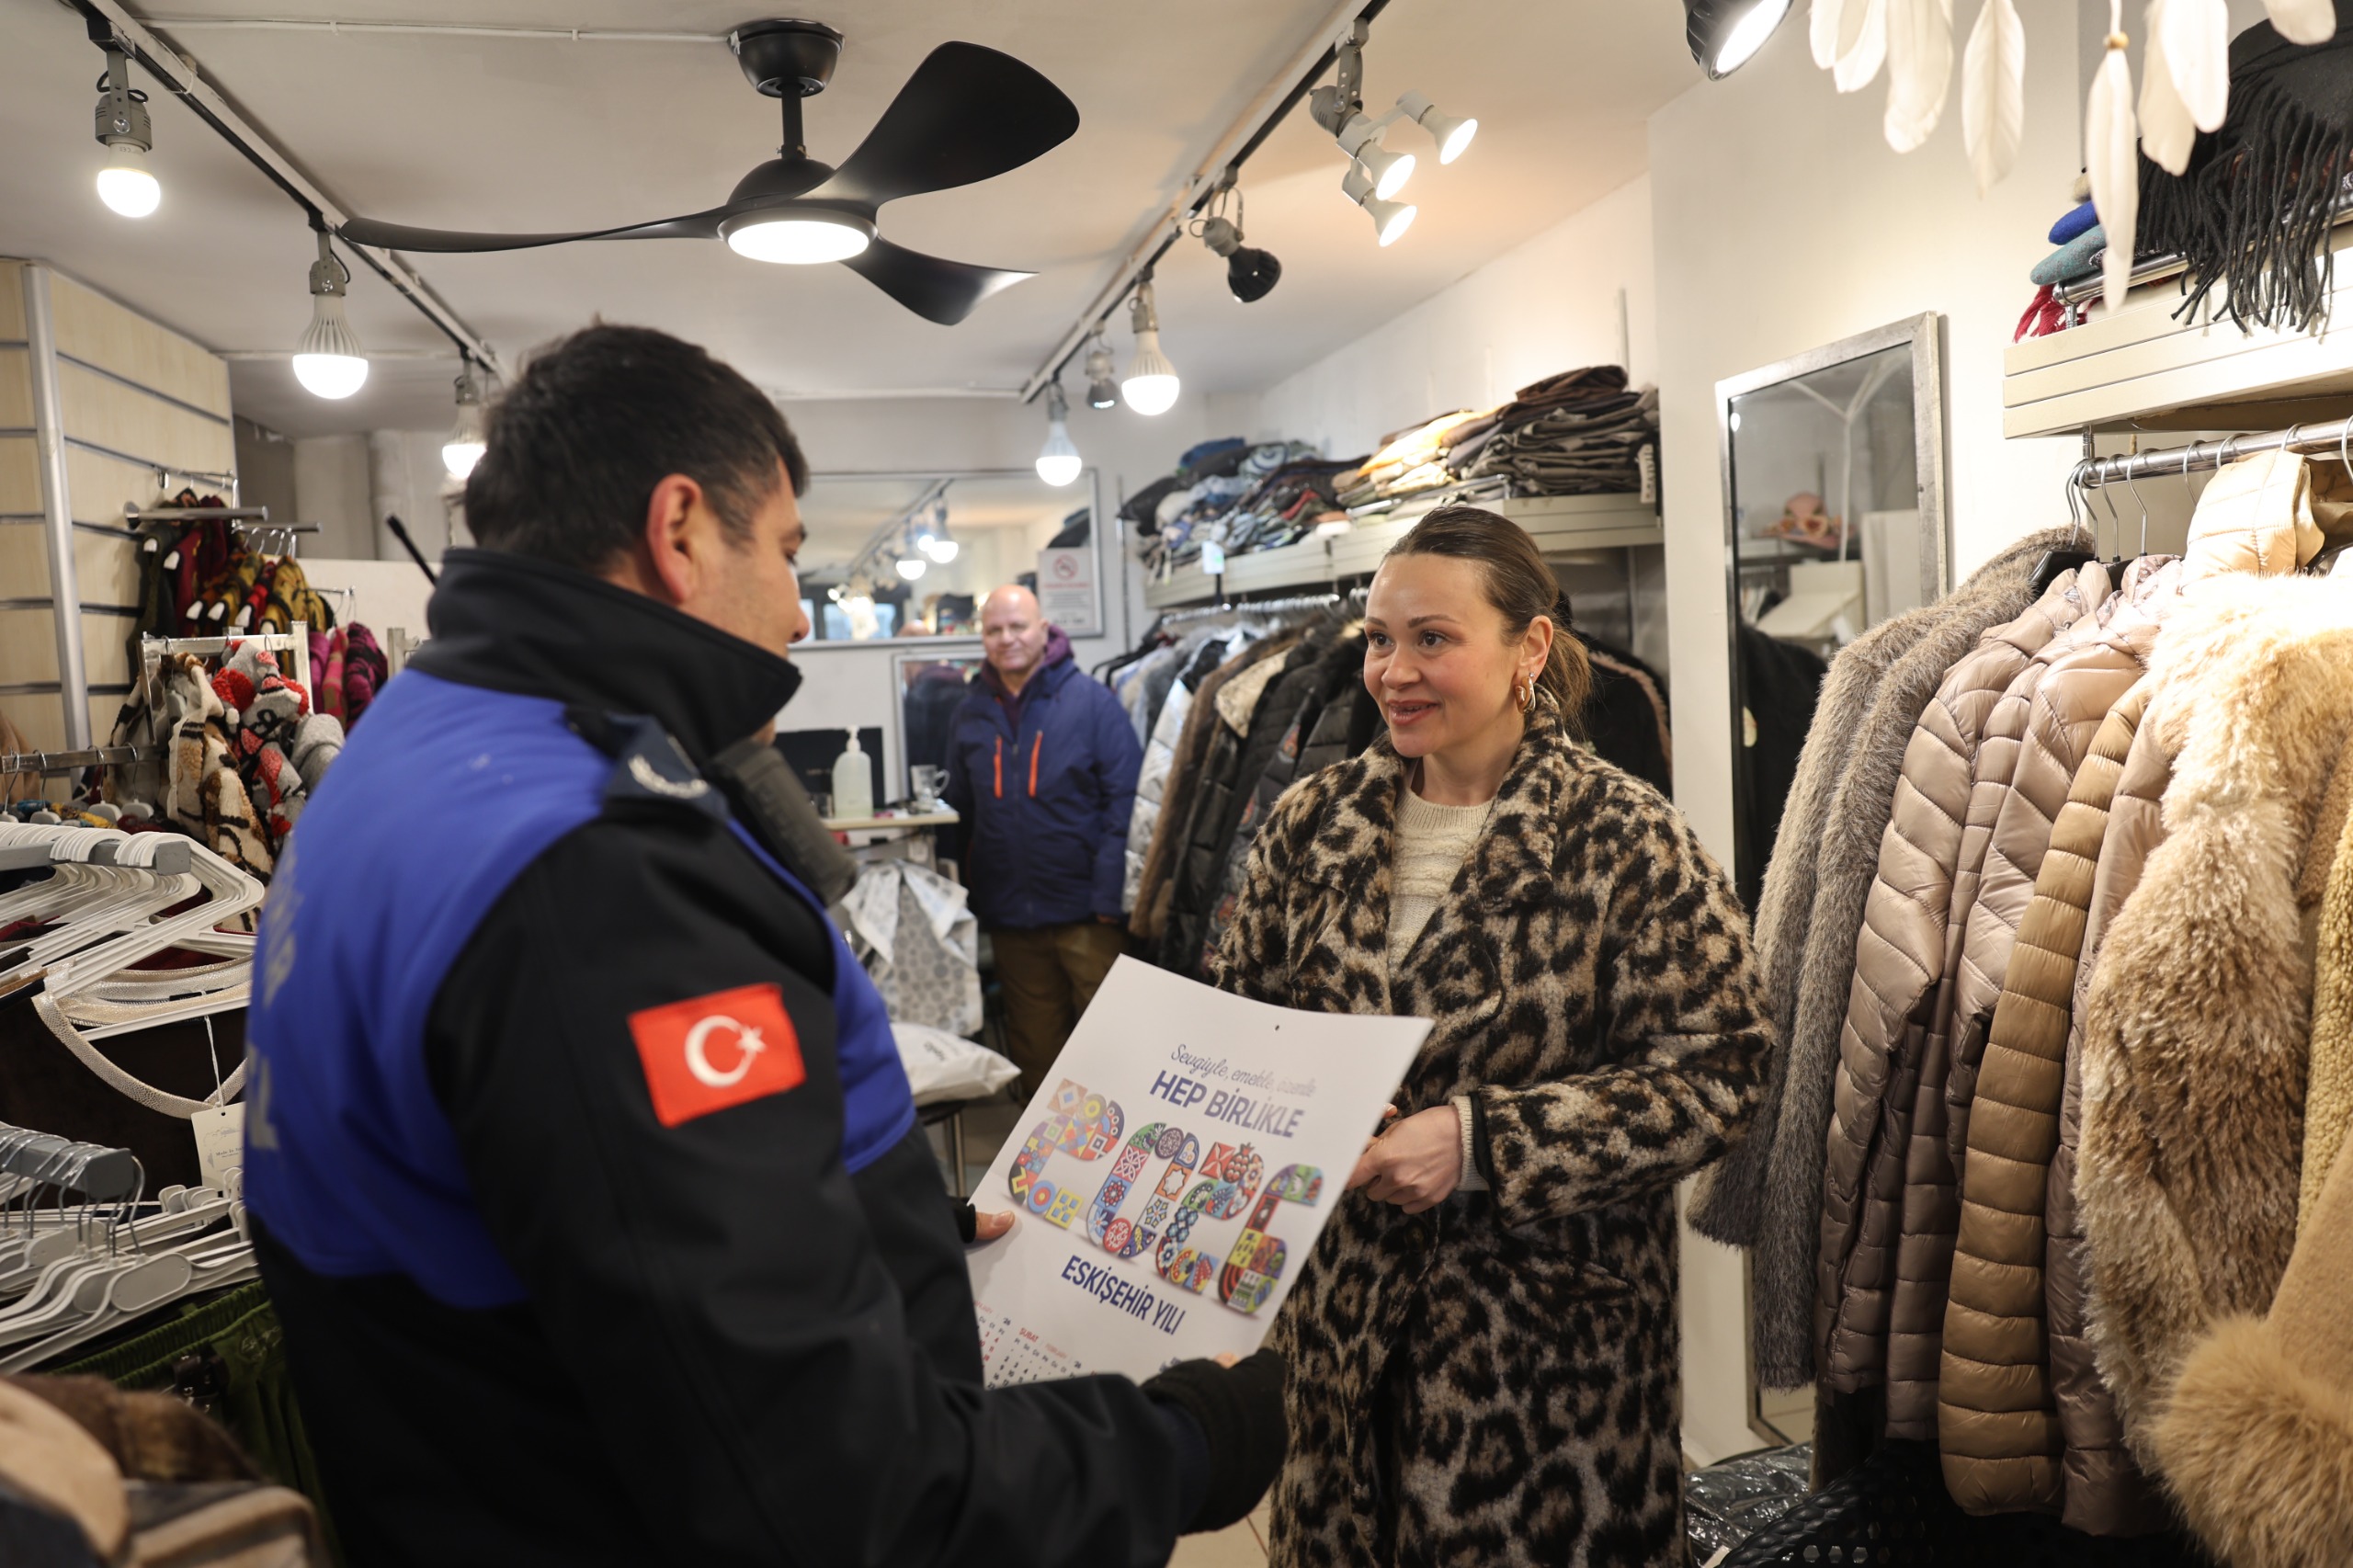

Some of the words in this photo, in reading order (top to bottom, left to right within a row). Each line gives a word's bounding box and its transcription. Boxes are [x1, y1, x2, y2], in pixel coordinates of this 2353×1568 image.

[1171, 1043, 1229, 1082] Sevgiyle,
[1149, 1070, 1208, 1108] HEP
[1204, 1087, 1304, 1138] BİRLİKLE
[1008, 1078, 1324, 1314] 2026
[1061, 1255, 1154, 1321] ESKİŞEHİR
[1152, 1299, 1187, 1335] YILI
